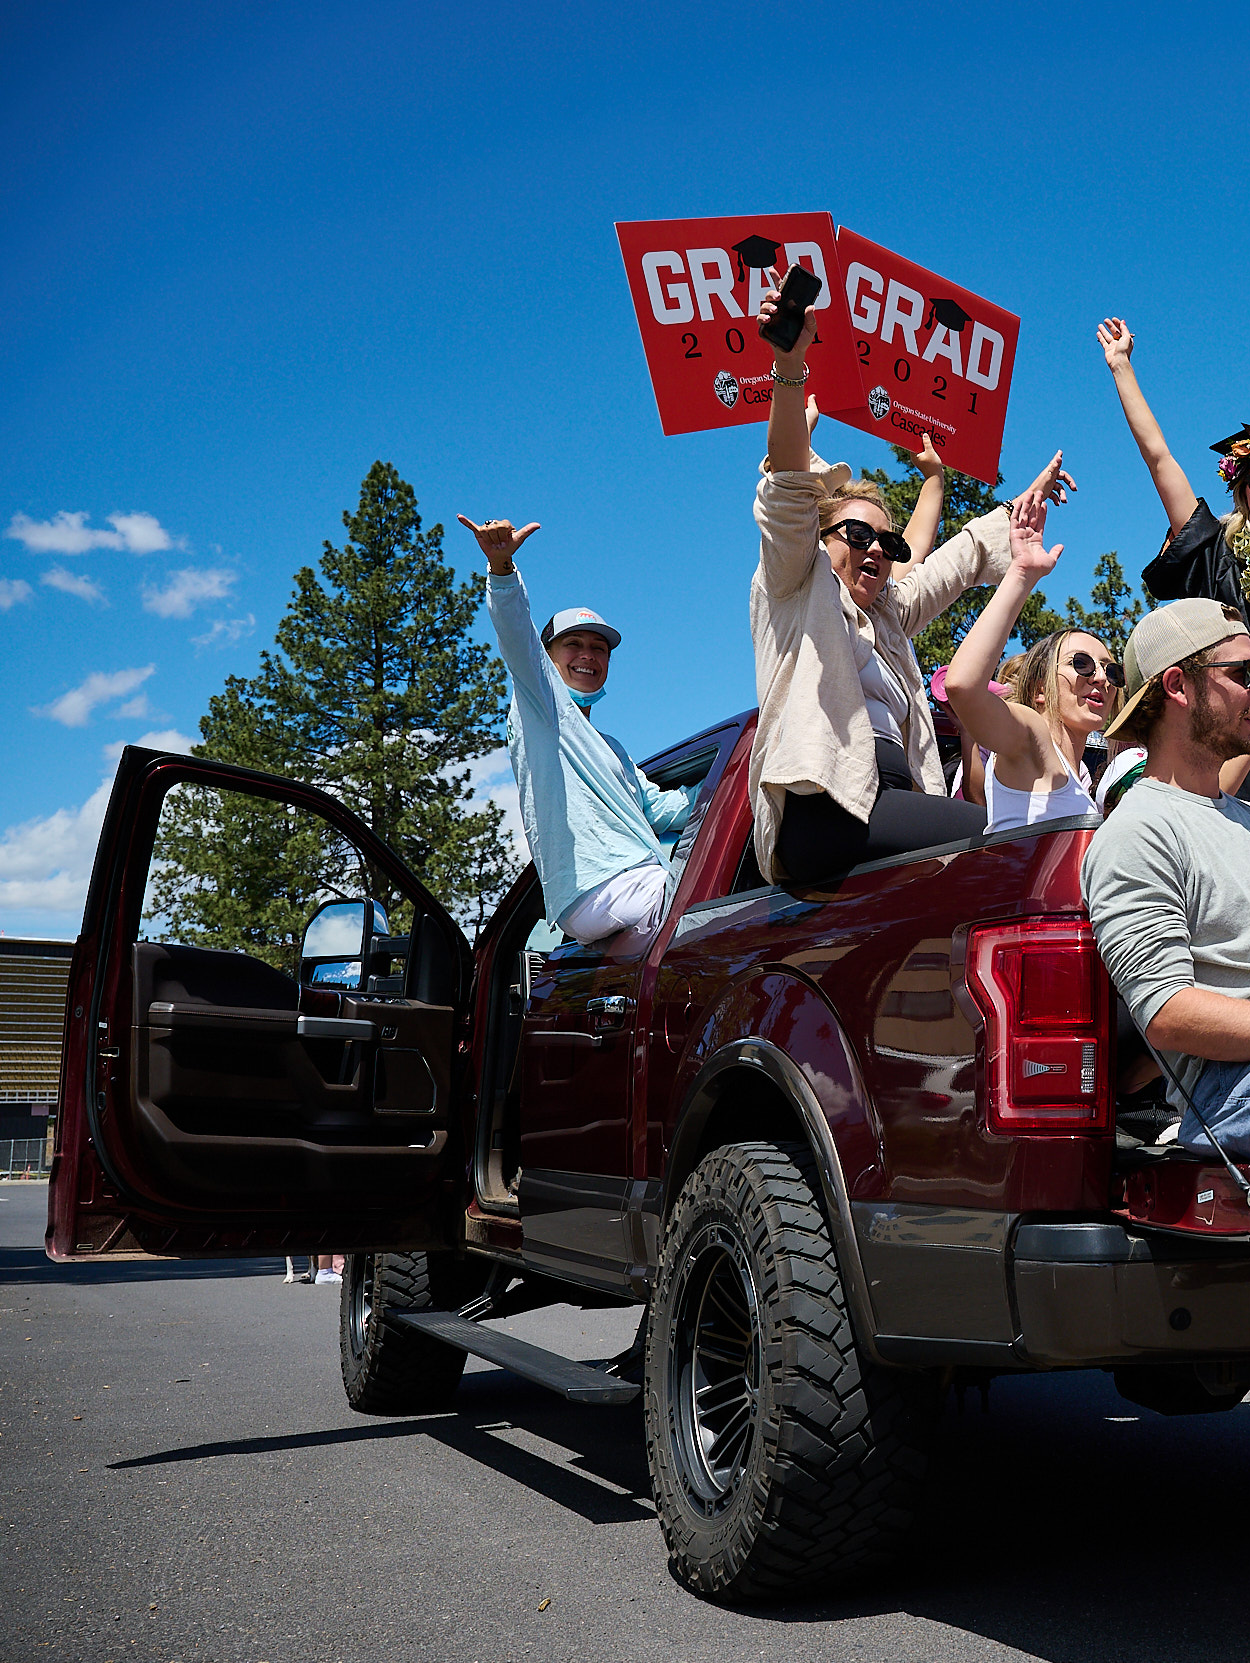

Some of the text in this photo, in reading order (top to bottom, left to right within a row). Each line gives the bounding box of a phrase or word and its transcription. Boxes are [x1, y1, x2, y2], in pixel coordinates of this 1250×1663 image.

[845, 262, 1005, 391] GRAD
[739, 376, 763, 386] Oregon
[743, 387, 773, 404] Casc
[891, 411, 947, 447] Cascades
[893, 400, 956, 435] Oregon State University
